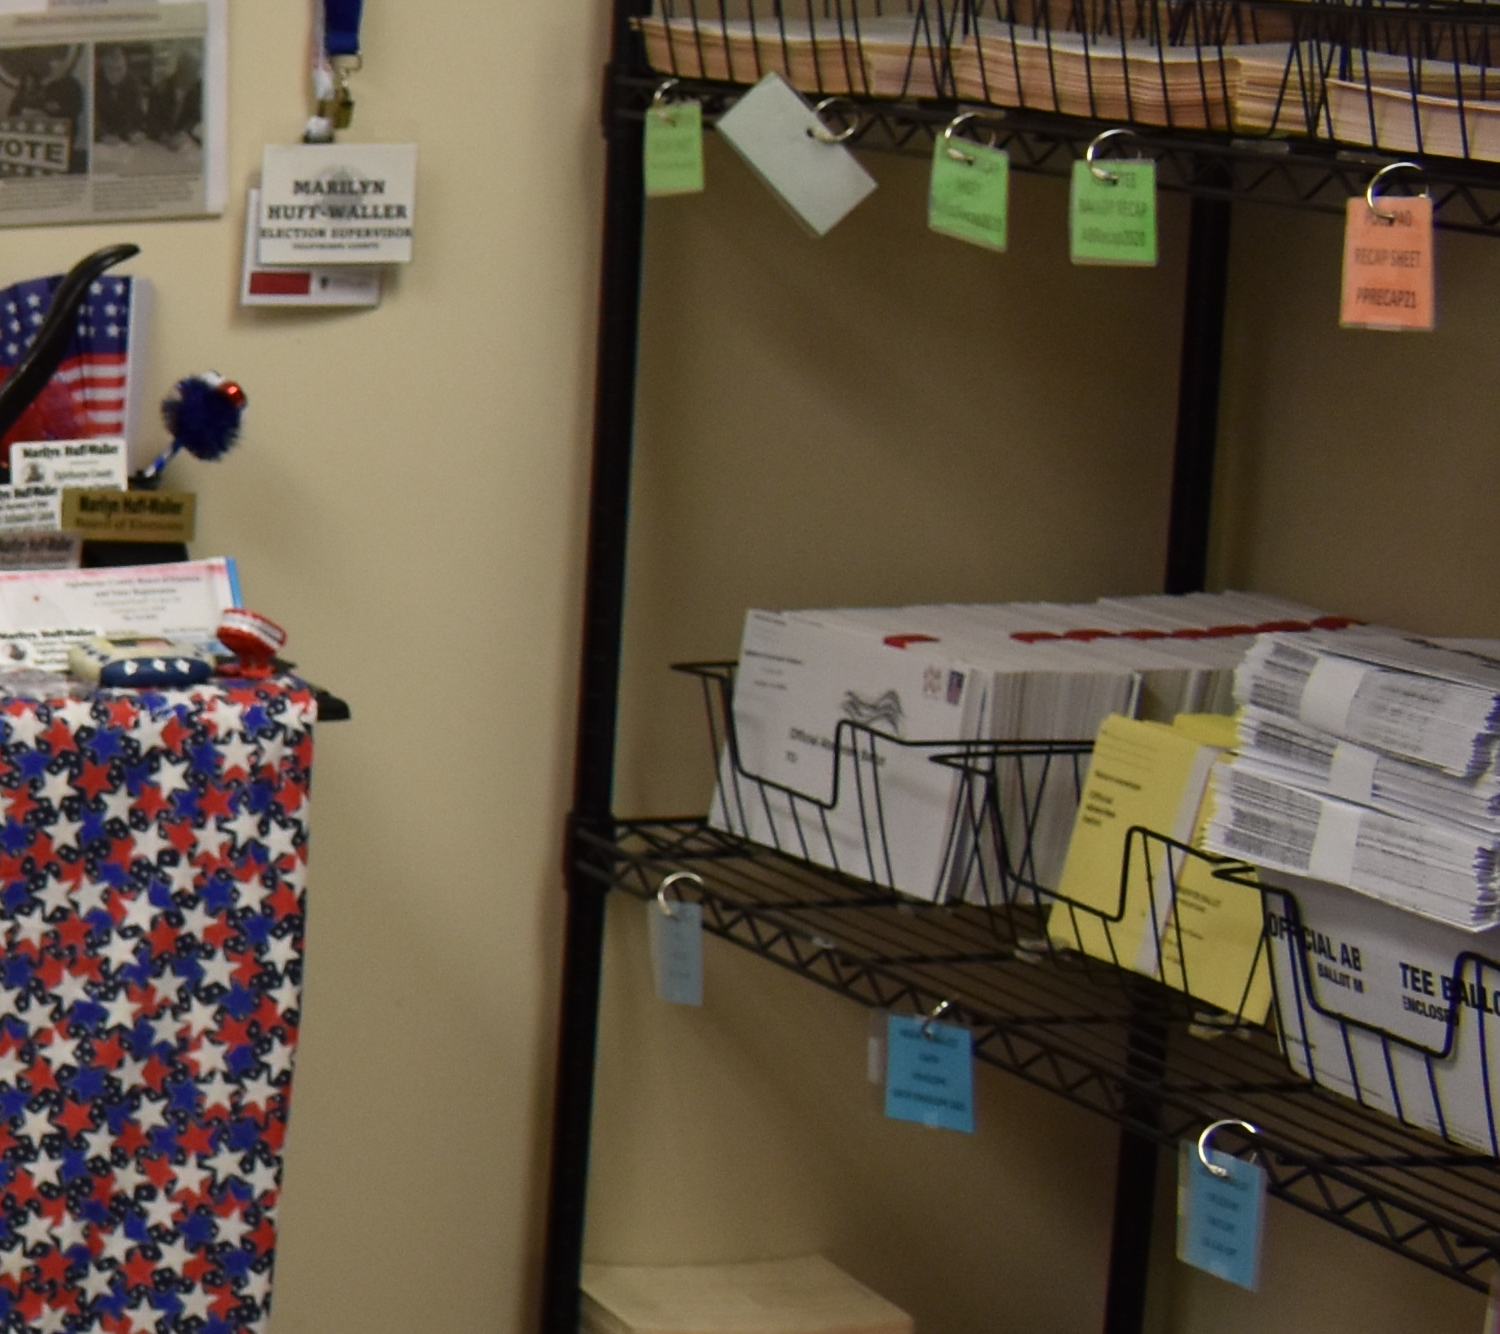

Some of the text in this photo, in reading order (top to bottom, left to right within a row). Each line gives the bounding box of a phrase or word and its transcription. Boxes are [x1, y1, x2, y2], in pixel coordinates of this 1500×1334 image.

[293, 179, 386, 195] MARILYN
[267, 203, 408, 220] HUFF-WALLER
[261, 227, 326, 239] ELECTION
[23, 447, 60, 459] Marilyn
[79, 495, 120, 515] Marilyn
[1266, 912, 1337, 964] OFCIAL
